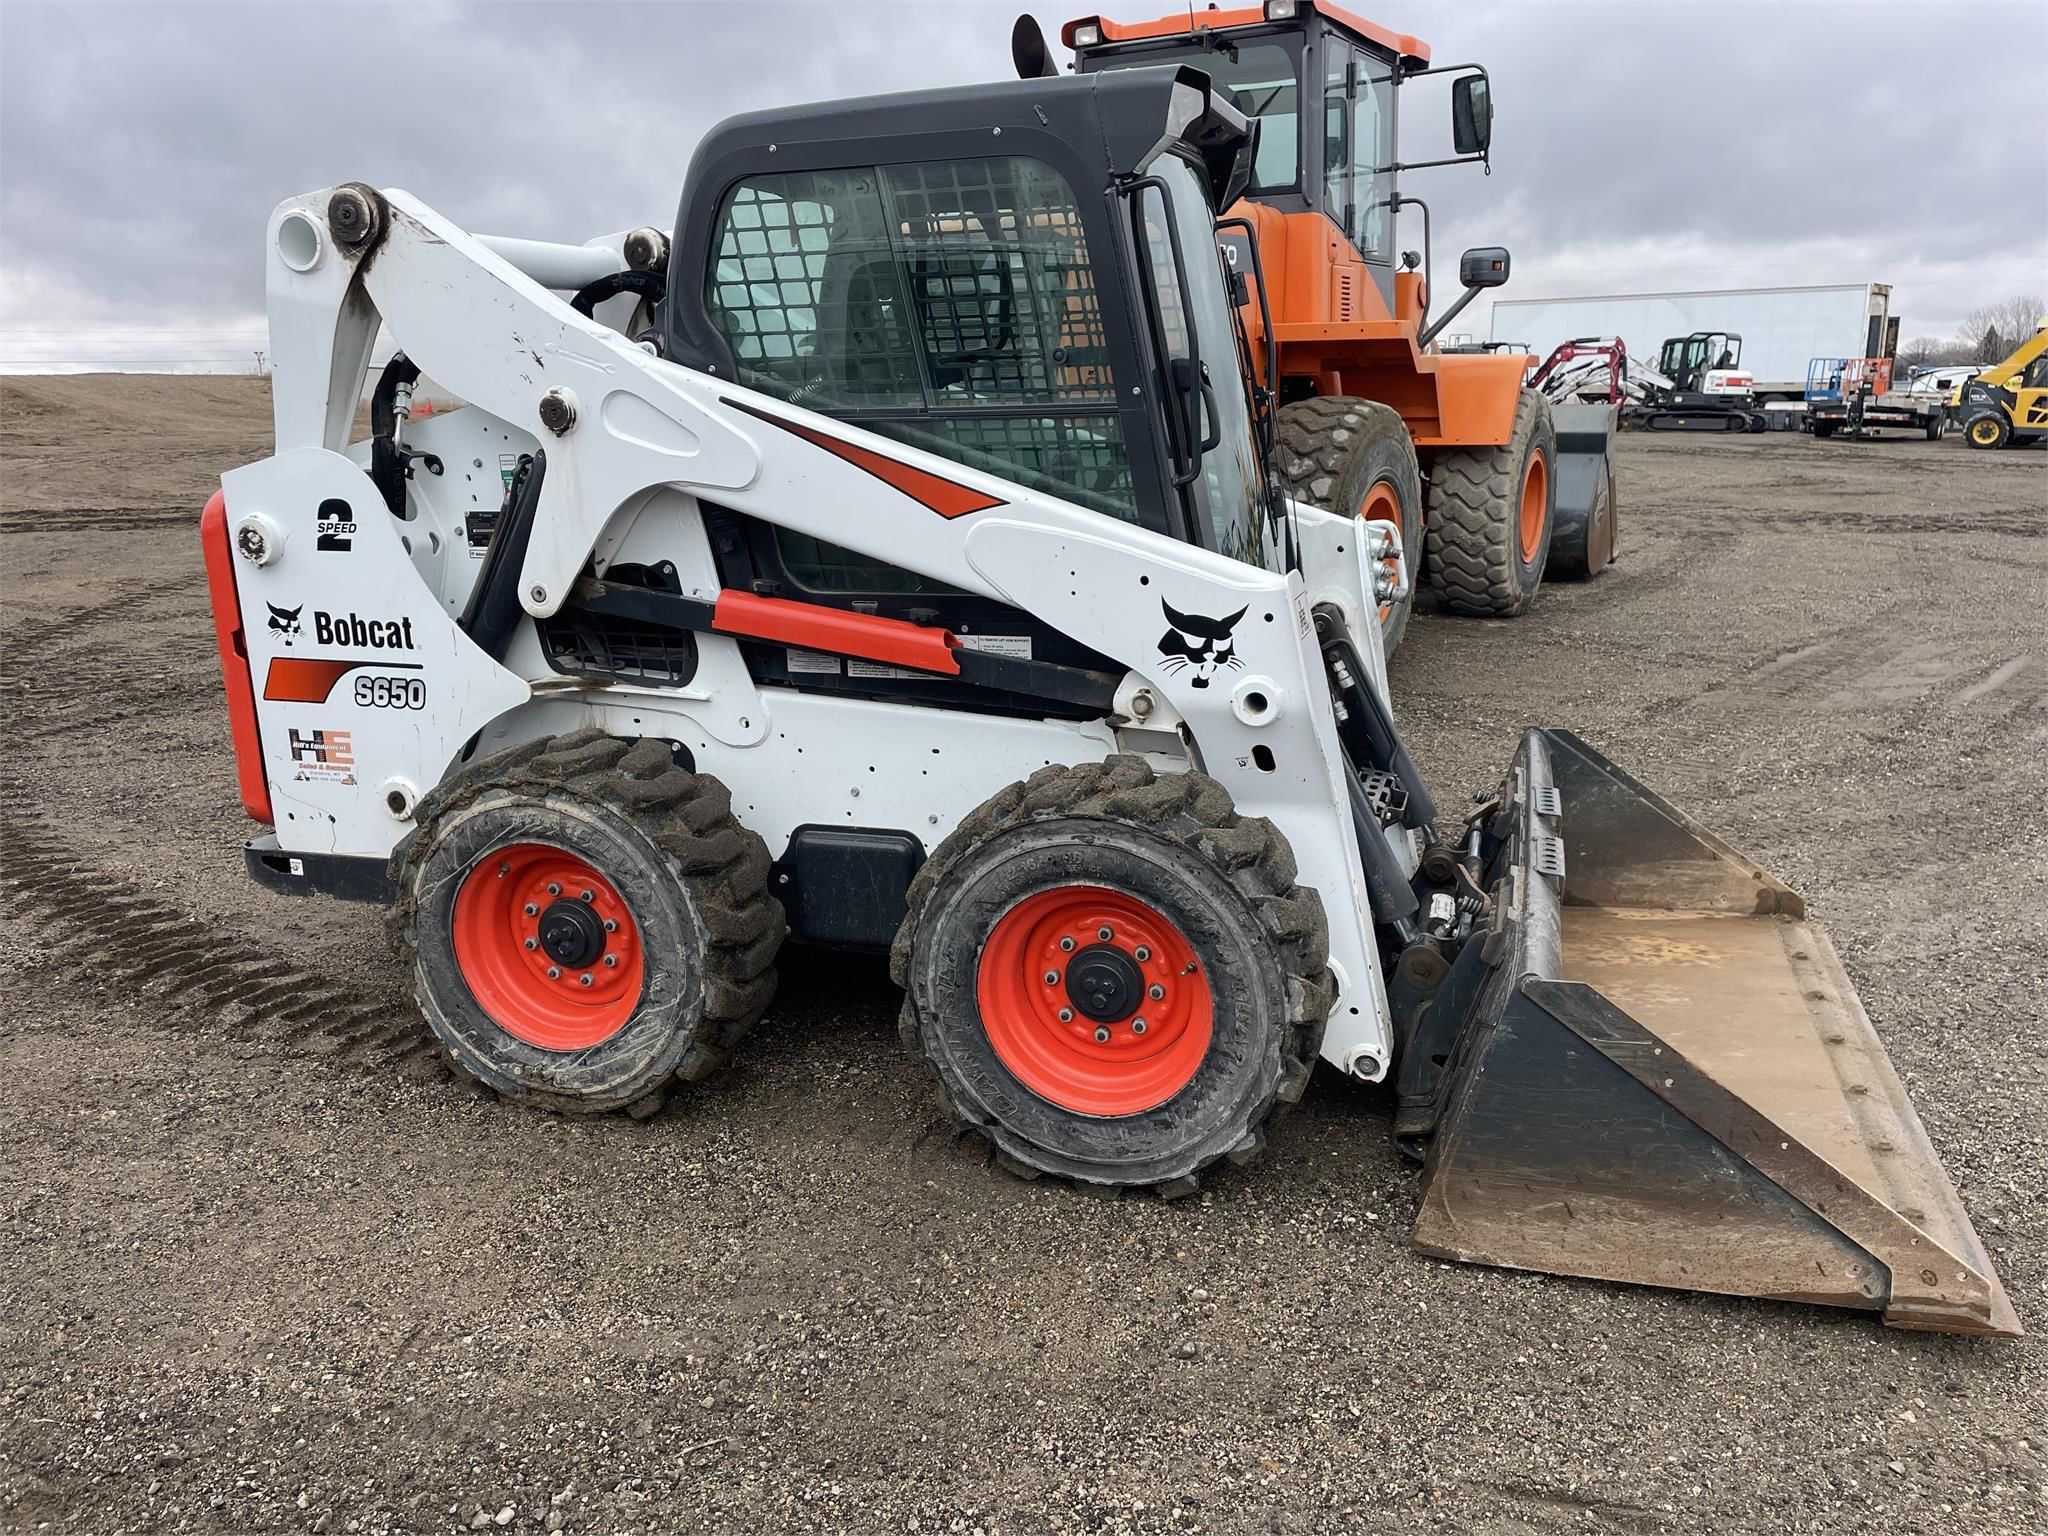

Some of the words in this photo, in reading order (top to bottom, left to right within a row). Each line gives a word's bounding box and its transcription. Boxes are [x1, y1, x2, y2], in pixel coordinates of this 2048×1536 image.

[1220, 244, 1237, 265] 0
[317, 498, 353, 552] 2
[317, 522, 357, 534] SPEED
[314, 611, 414, 650] Bobcat
[354, 675, 426, 711] S650
[288, 728, 354, 765] HE
